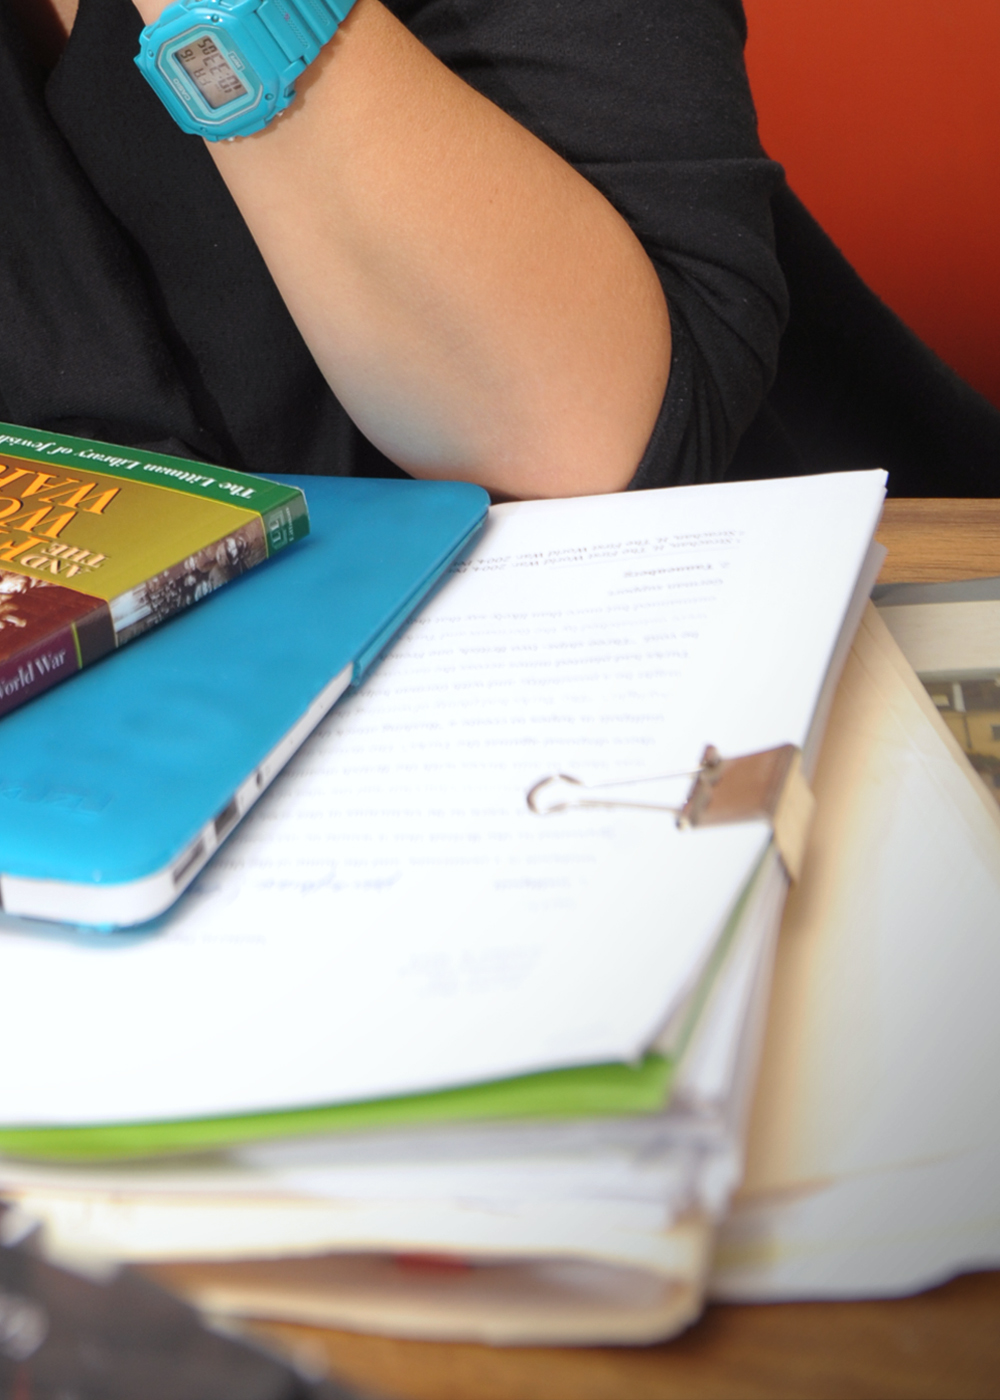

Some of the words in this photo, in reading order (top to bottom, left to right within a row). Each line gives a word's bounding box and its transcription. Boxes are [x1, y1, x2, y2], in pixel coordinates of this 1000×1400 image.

[172, 76, 191, 100] CASIO
[47, 445, 73, 456] of
[72, 449, 141, 471] Library
[143, 463, 217, 488] Littman
[219, 482, 256, 500] The
[20, 555, 90, 578] AND
[40, 542, 107, 569] THE
[32, 648, 67, 677] War
